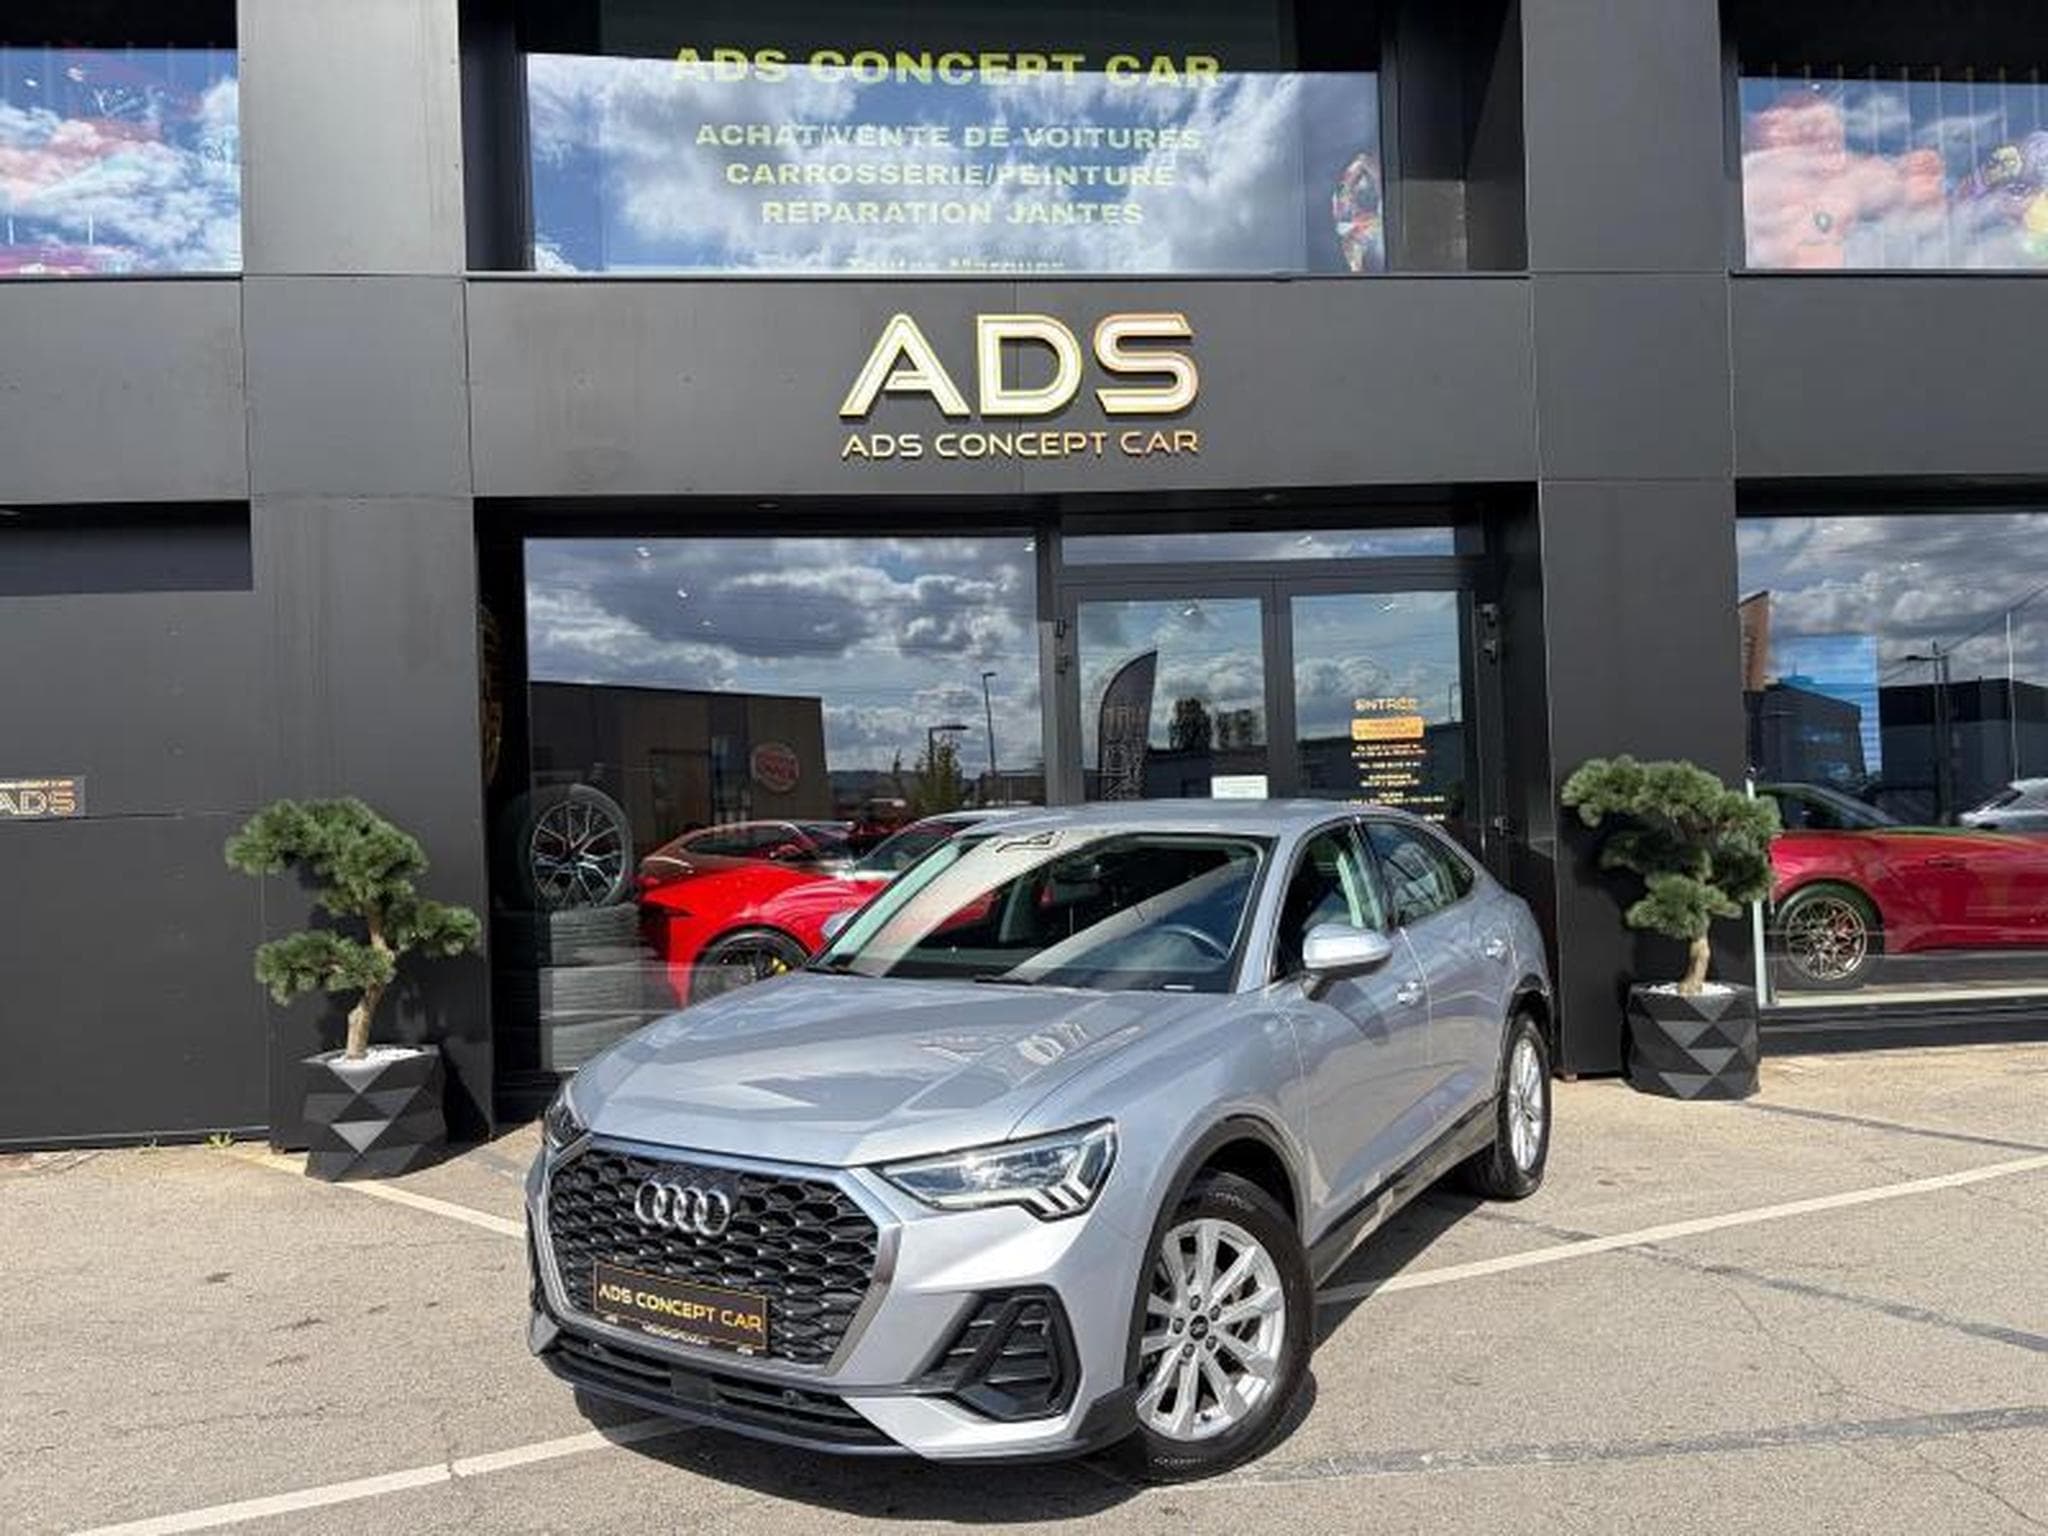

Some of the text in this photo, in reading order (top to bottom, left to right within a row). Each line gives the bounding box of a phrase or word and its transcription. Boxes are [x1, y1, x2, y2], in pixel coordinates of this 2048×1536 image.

[672, 47, 1221, 87] ADS CONCEPT CAR
[963, 127, 1011, 148] DE
[1022, 127, 1203, 150] VOITURES
[1006, 203, 1145, 226] JANTES
[839, 312, 1200, 416] ADS
[841, 430, 1199, 459] ADS CONCEPT CAR
[598, 1283, 633, 1305] ADS
[635, 1291, 716, 1323] CONCEPT
[720, 1309, 763, 1333] CAR
